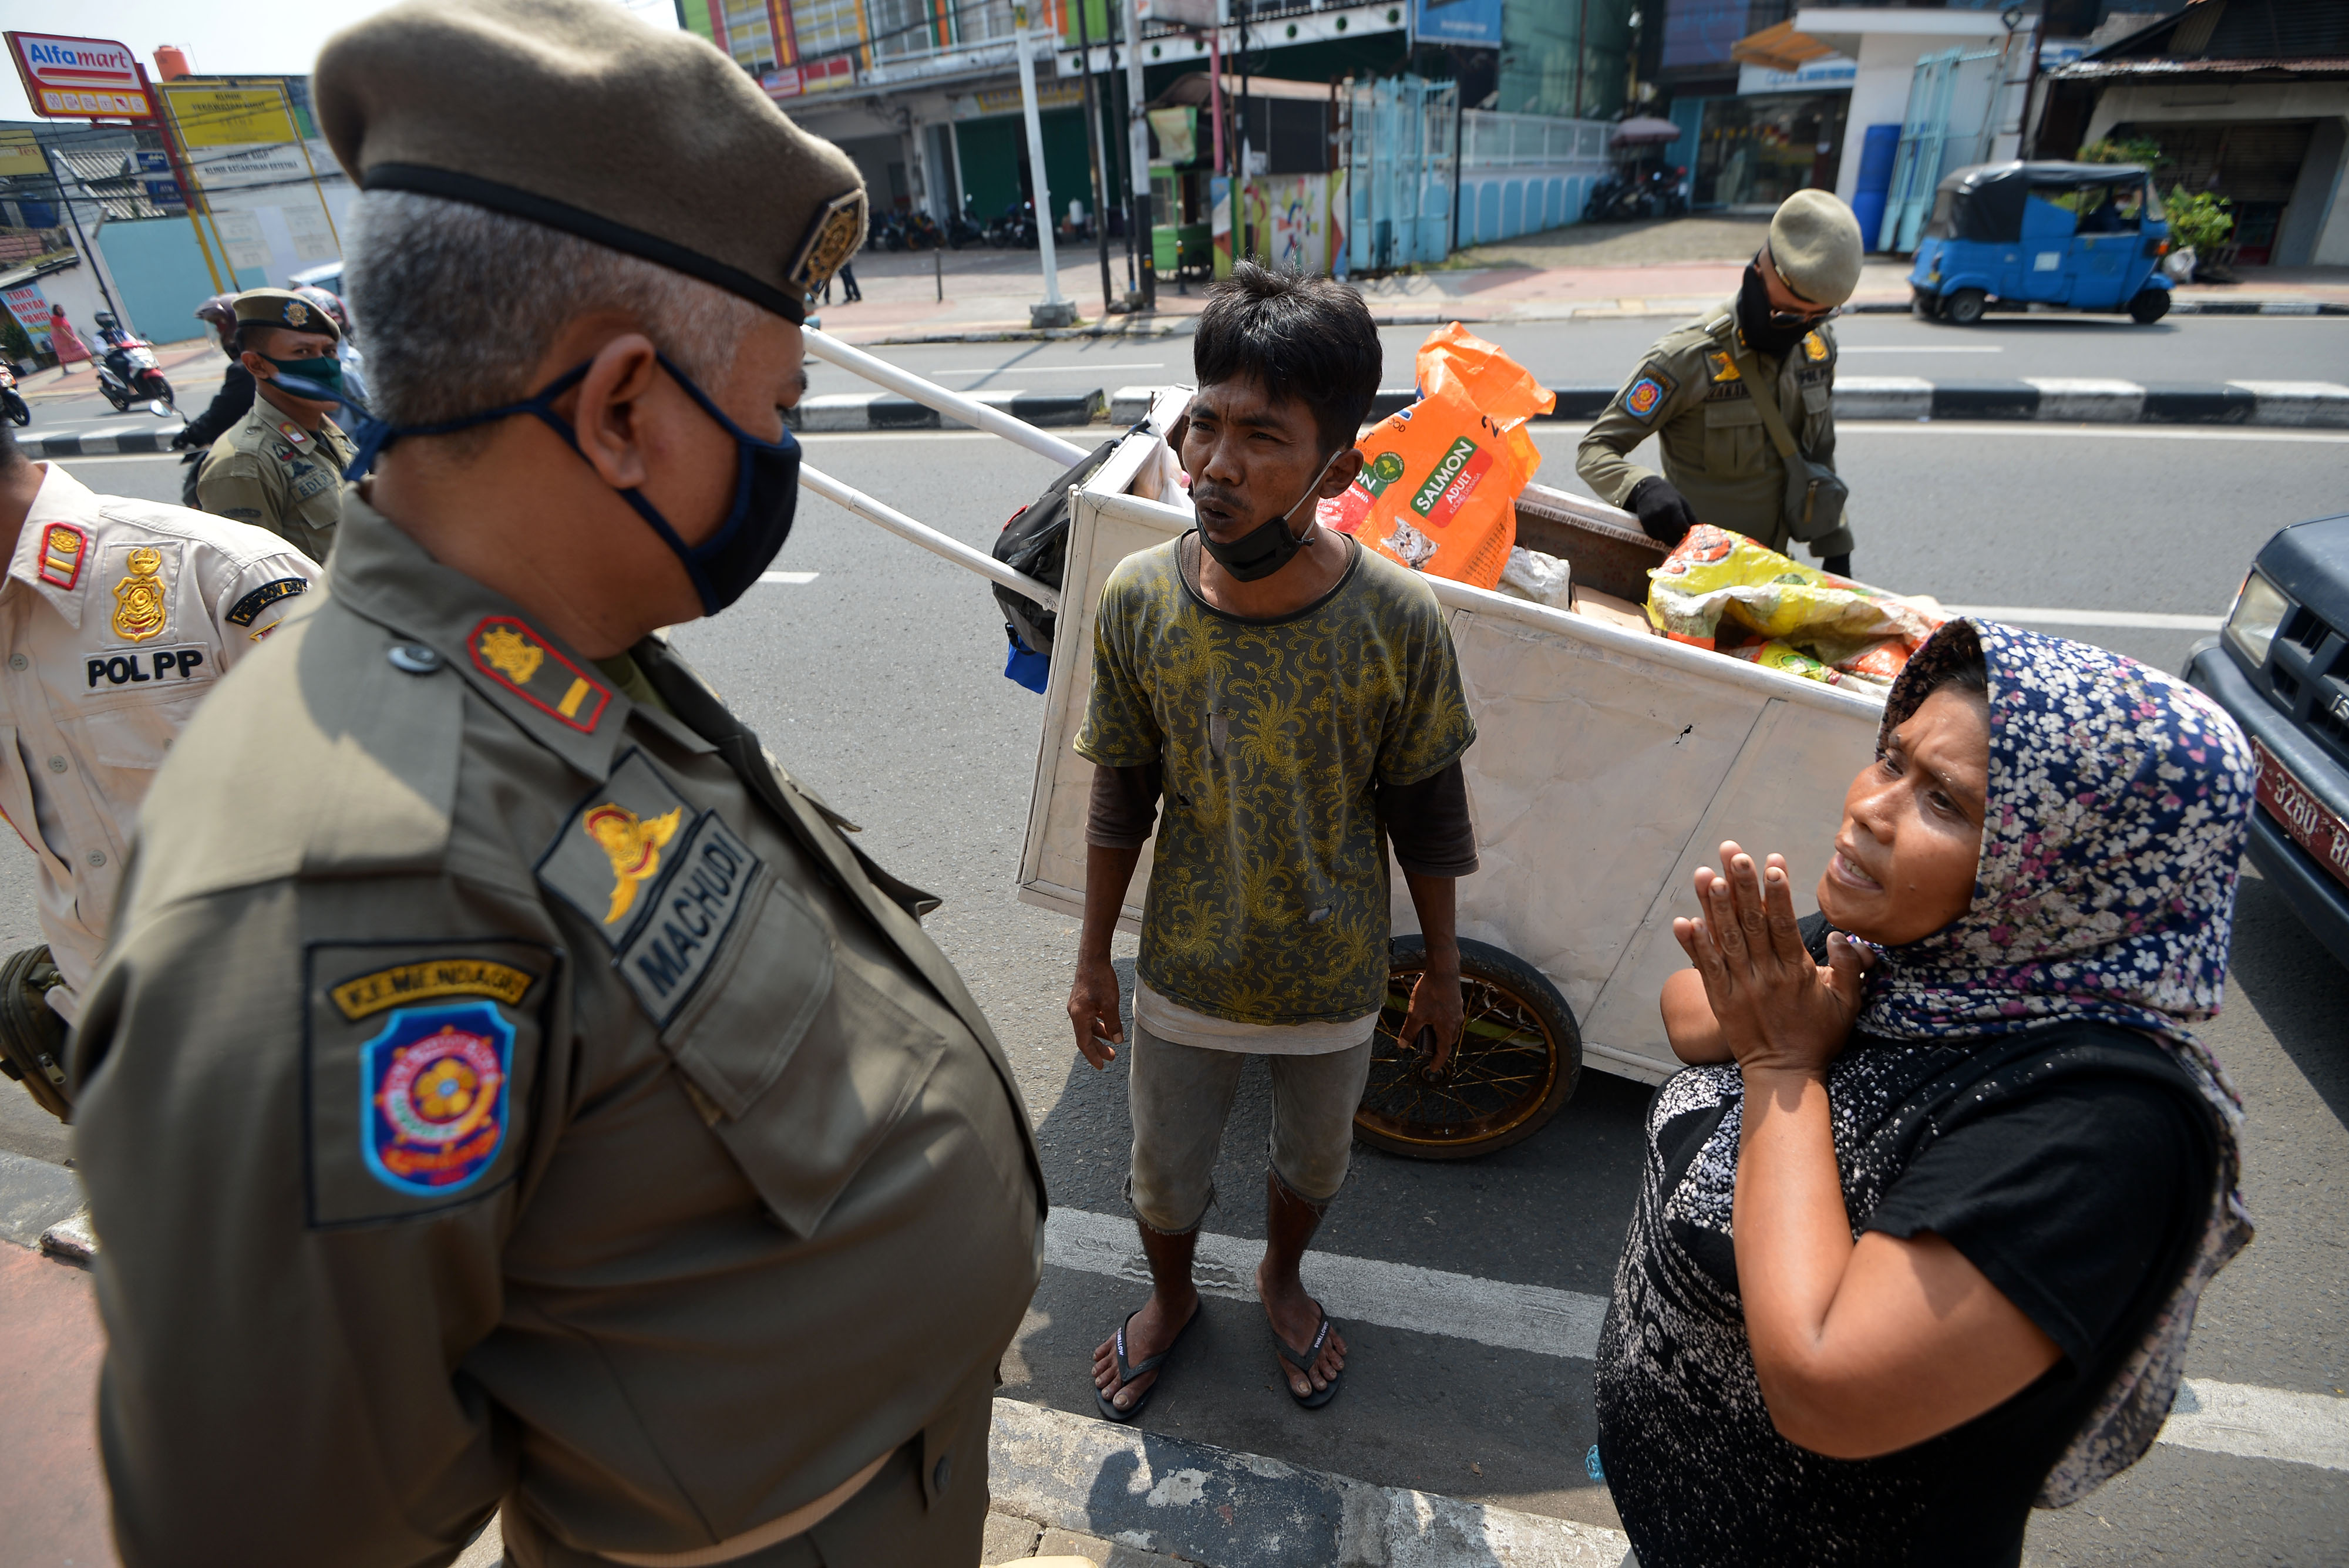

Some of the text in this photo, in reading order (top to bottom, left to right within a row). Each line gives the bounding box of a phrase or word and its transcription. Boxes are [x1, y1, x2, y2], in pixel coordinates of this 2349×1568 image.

[31, 44, 128, 69] Alfamart
[5, 288, 34, 301] TOKO
[10, 298, 47, 314] MINYAK
[1416, 440, 1473, 510] SALMON
[1446, 470, 1472, 504] ADULT
[1449, 472, 1482, 514] KUCING DEWASA
[88, 650, 203, 687] POL PP
[637, 831, 743, 997] MACHUDI
